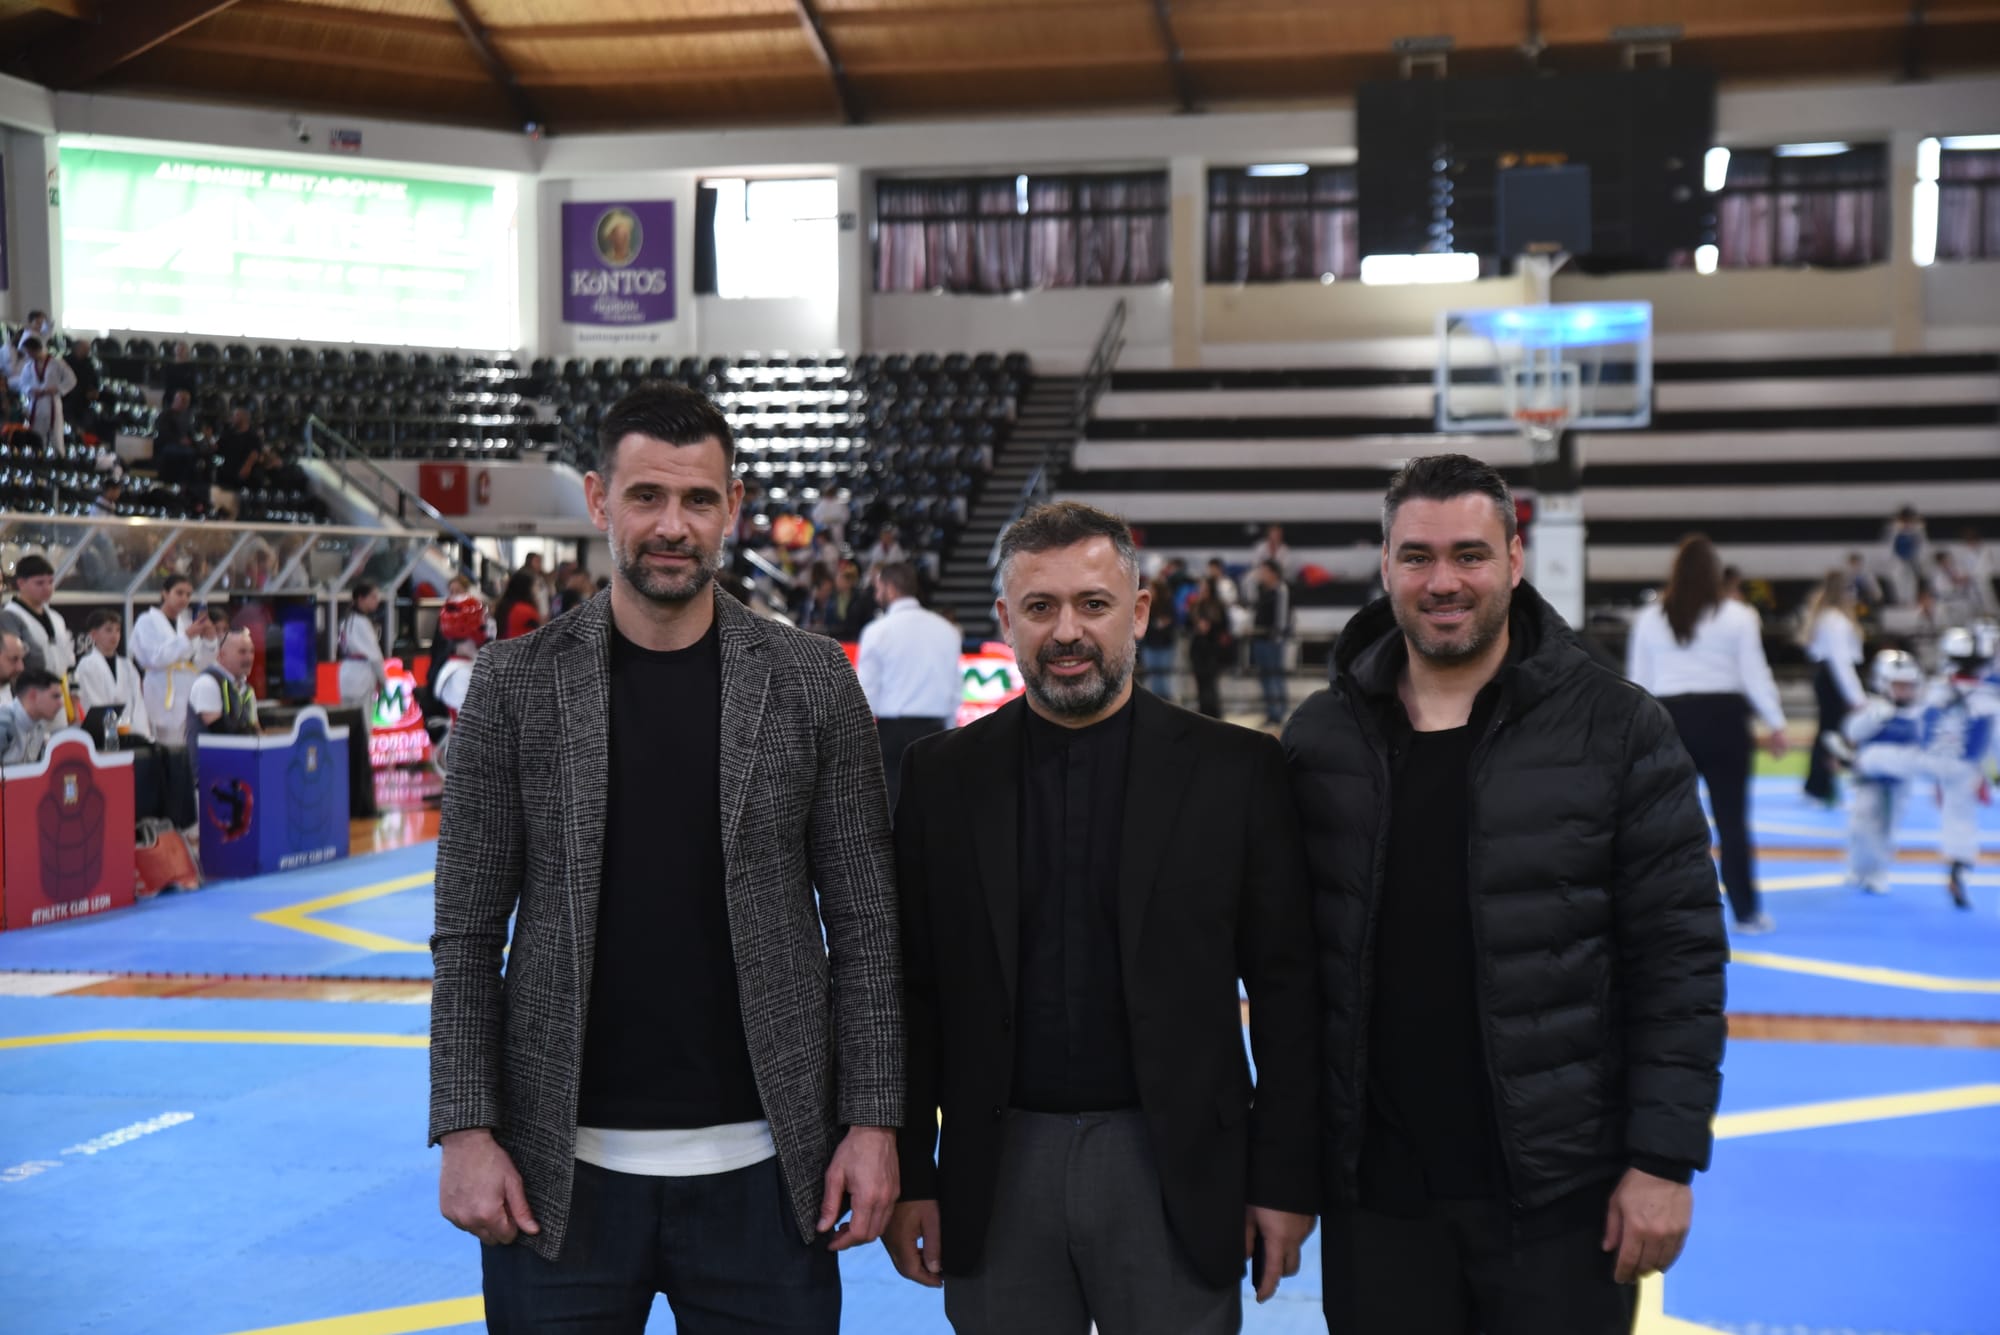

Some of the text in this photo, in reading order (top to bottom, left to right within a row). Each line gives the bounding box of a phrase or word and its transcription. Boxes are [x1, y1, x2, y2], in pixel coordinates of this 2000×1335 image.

[269, 172, 408, 200] ΜΕΤΑΦΟΡΕΣ
[32, 893, 111, 926] ATHLETIC CLUB LEON
